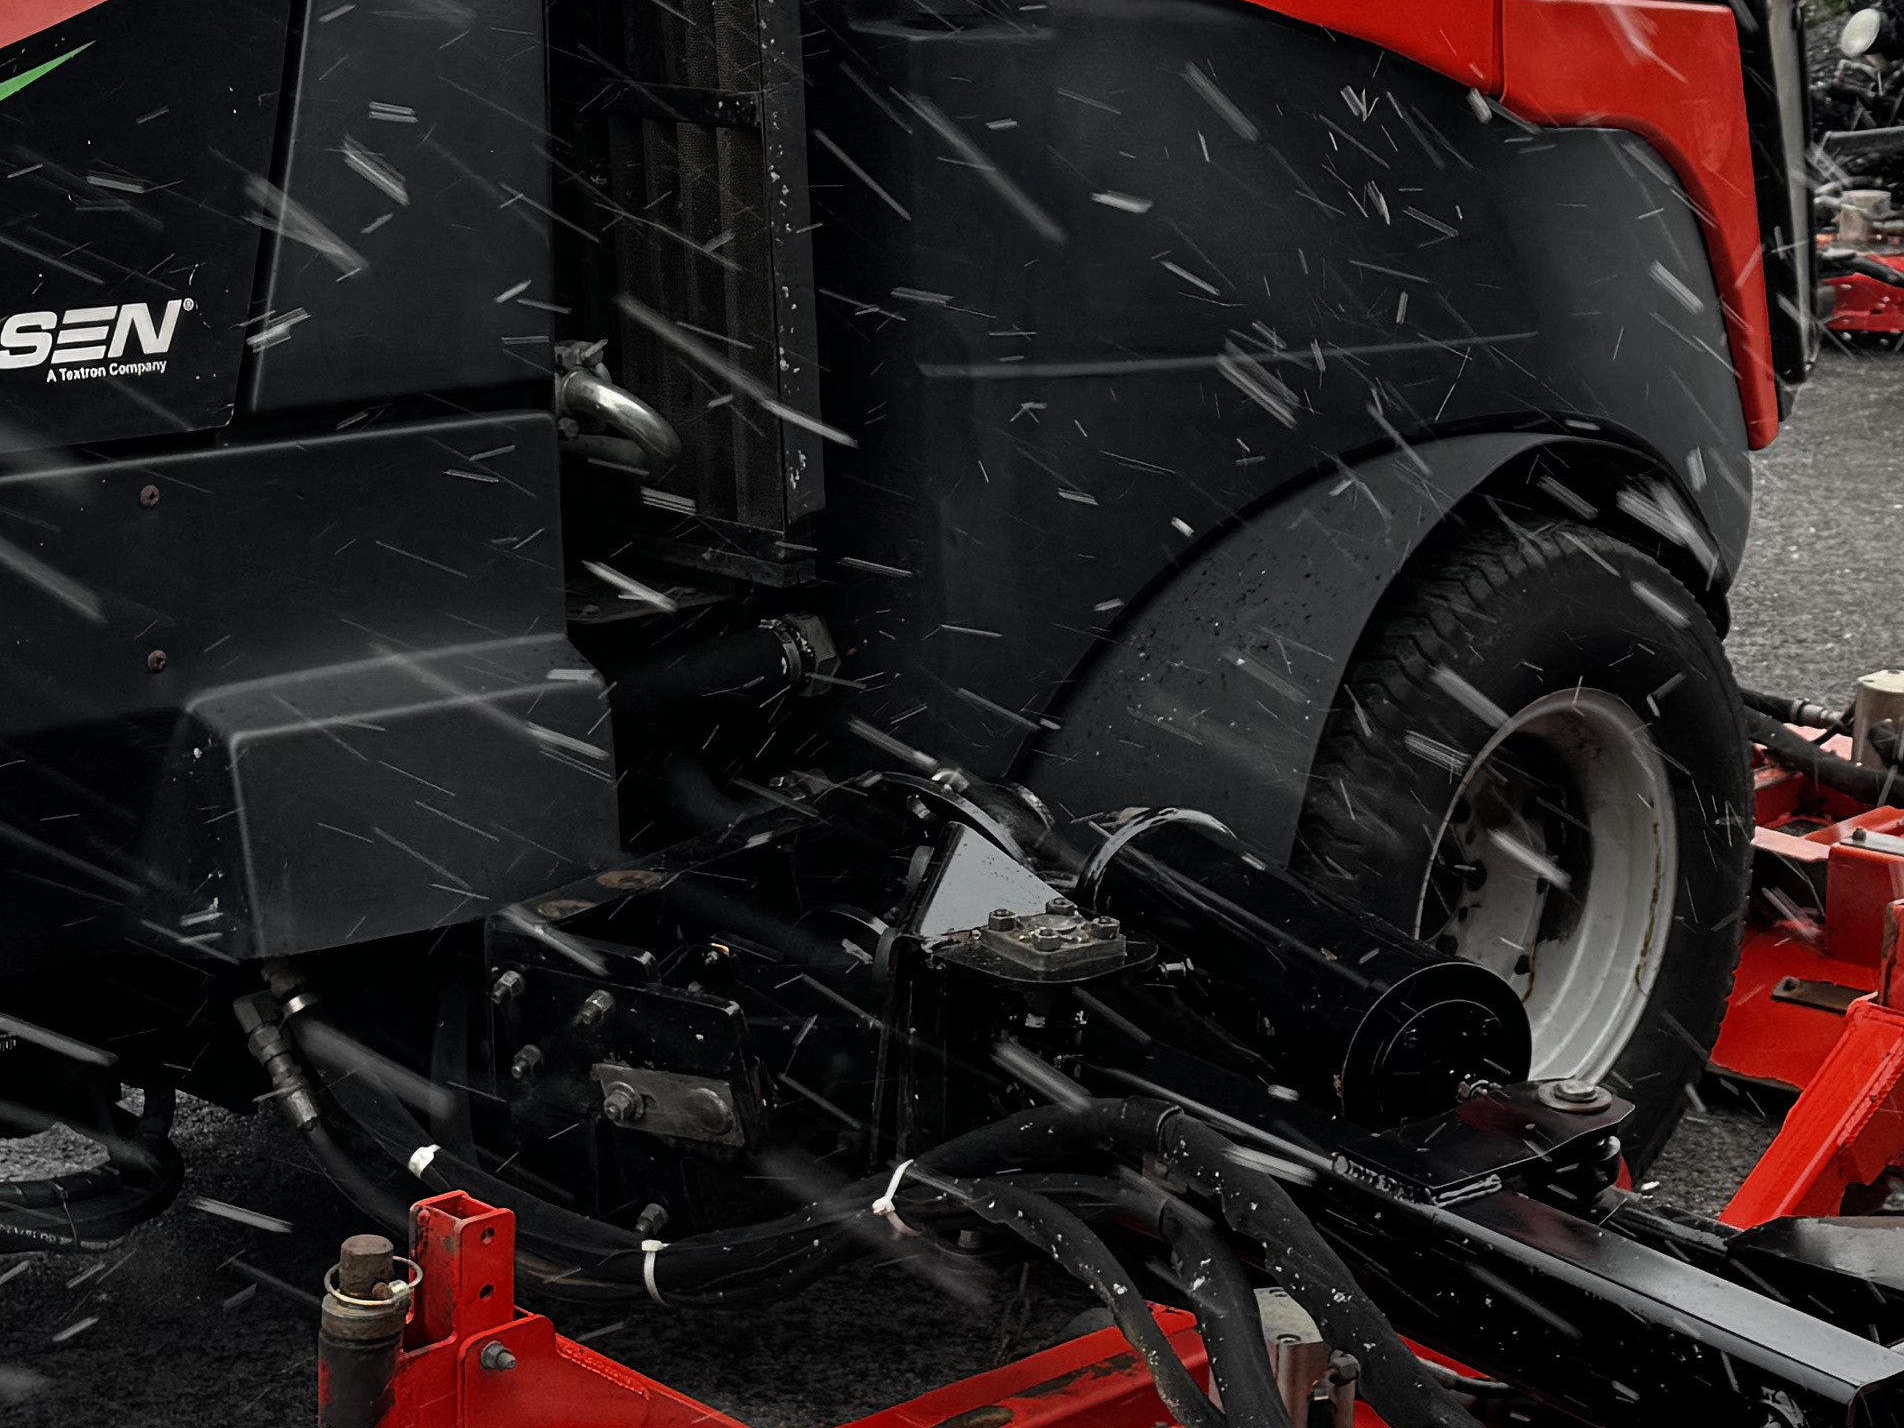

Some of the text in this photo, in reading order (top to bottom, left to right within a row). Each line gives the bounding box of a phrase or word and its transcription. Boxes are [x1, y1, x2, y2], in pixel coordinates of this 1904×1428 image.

[46, 360, 168, 383] A Textron Company
